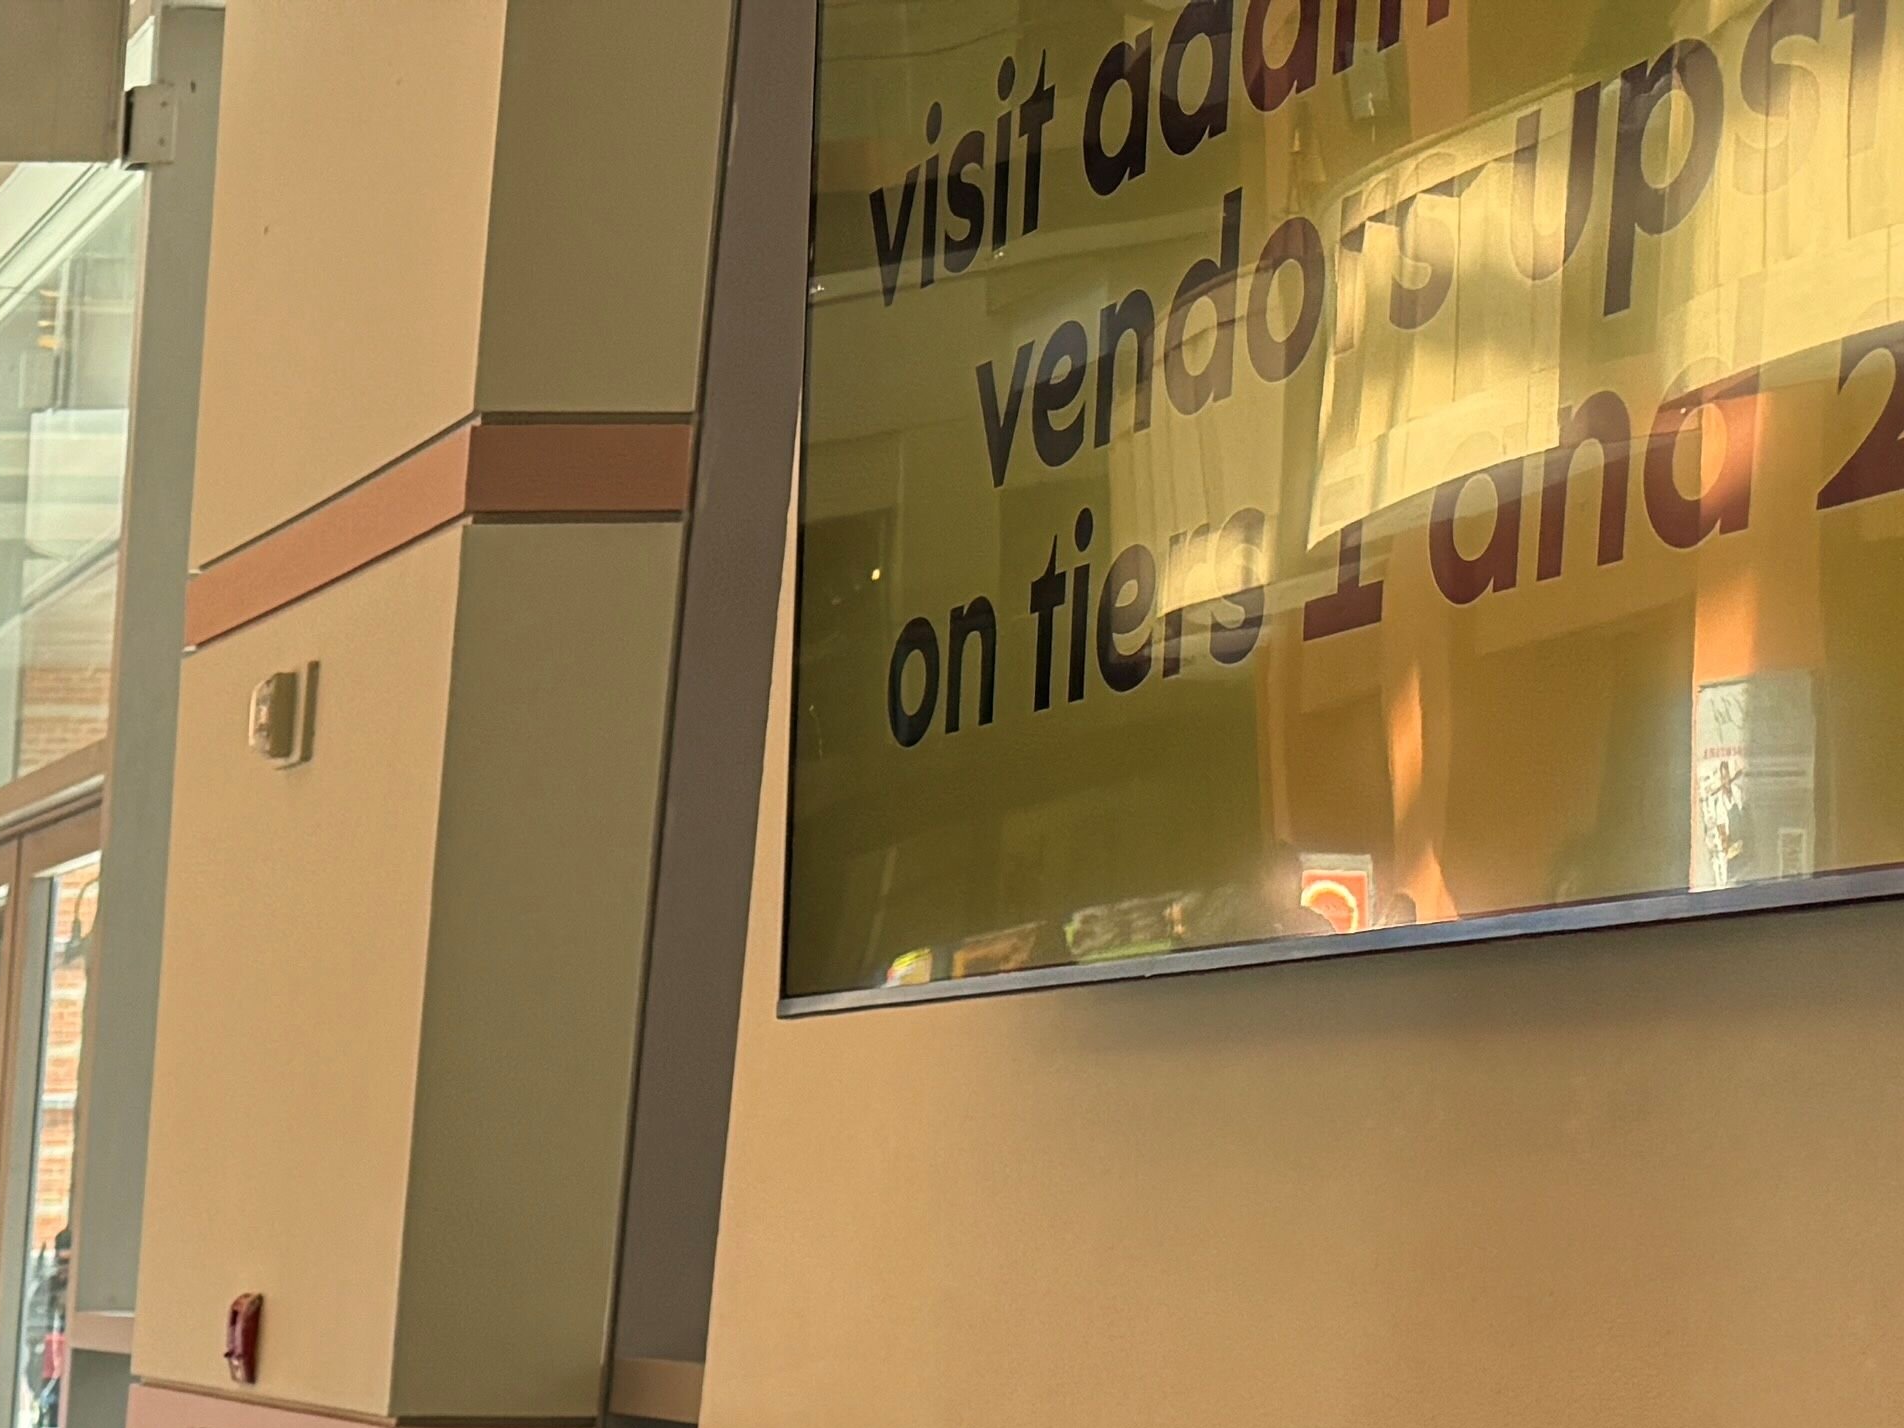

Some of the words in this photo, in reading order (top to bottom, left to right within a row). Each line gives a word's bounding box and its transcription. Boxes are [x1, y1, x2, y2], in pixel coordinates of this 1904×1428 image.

[870, 50, 1055, 307] visit
[976, 150, 1460, 488] vendors
[888, 593, 994, 748] on
[1031, 506, 1269, 712] tiers
[1302, 450, 1385, 643] 1
[1429, 271, 1763, 606] and
